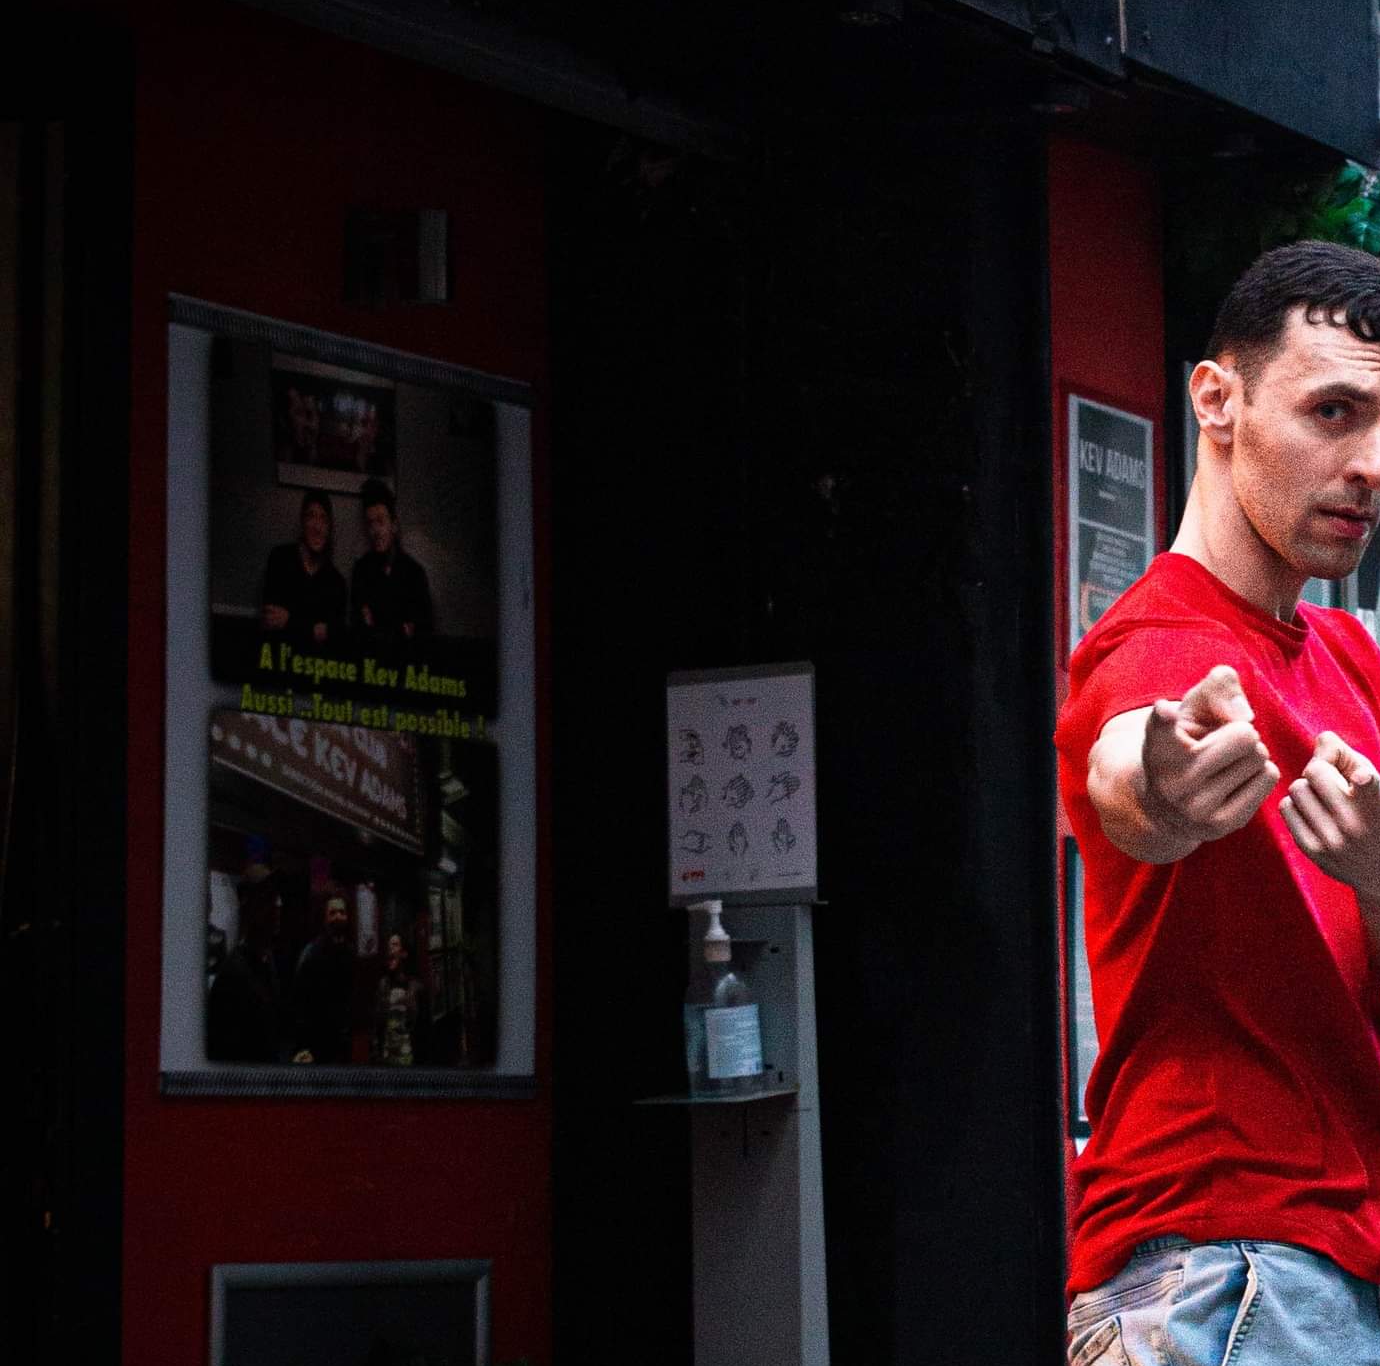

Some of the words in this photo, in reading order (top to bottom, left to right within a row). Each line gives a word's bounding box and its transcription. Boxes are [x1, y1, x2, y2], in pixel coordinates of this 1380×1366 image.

[258, 641, 274, 671] A
[279, 642, 358, 685] l'espace
[362, 658, 399, 688] Kev
[404, 664, 468, 698] Adams
[240, 683, 294, 716] Aussi
[360, 706, 389, 727] est
[395, 708, 471, 741] possible
